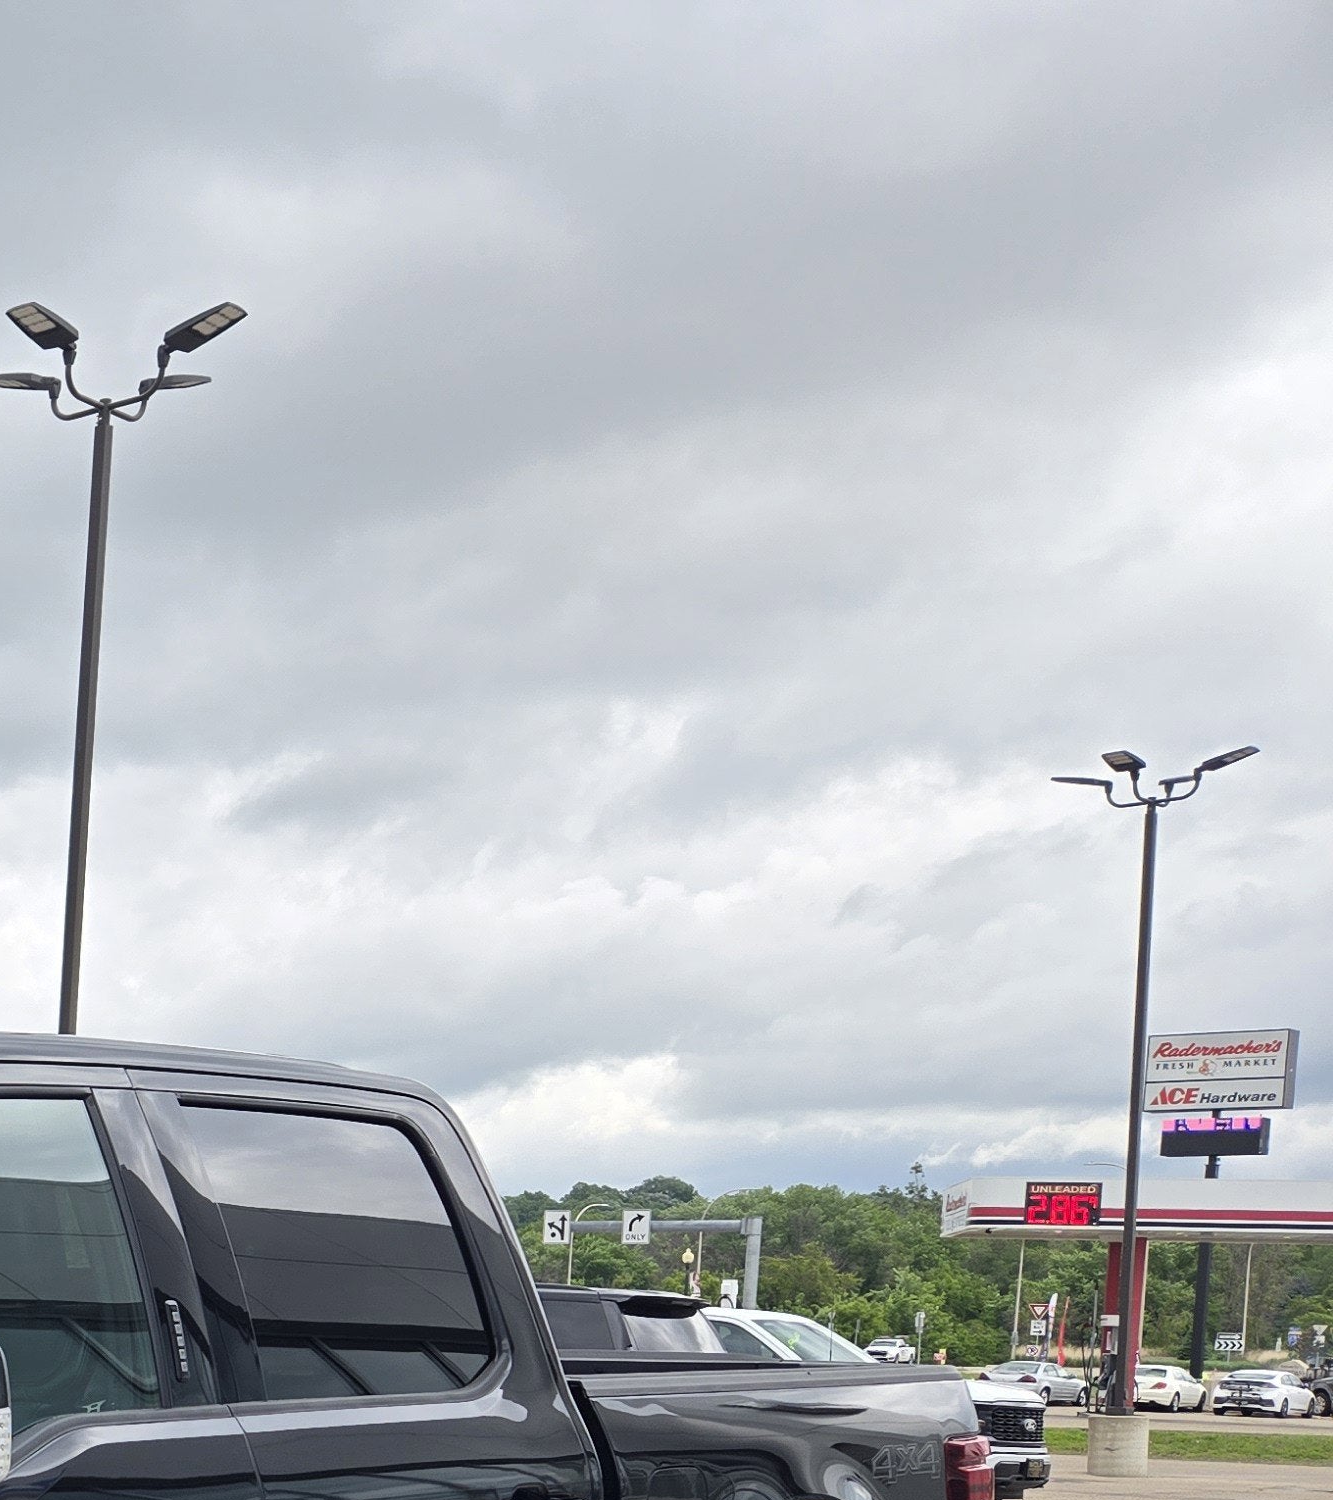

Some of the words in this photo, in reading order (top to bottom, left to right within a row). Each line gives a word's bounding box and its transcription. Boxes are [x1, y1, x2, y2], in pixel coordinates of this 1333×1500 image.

[1152, 1039, 1283, 1059] Radermacher's
[1155, 1061, 1194, 1071] FRESH
[1222, 1058, 1277, 1068] MARKET
[1150, 1086, 1200, 1106] ACE
[1199, 1091, 1277, 1104] Hardware
[1031, 1185, 1096, 1194] UNLEADED
[625, 1233, 646, 1241] ONLY
